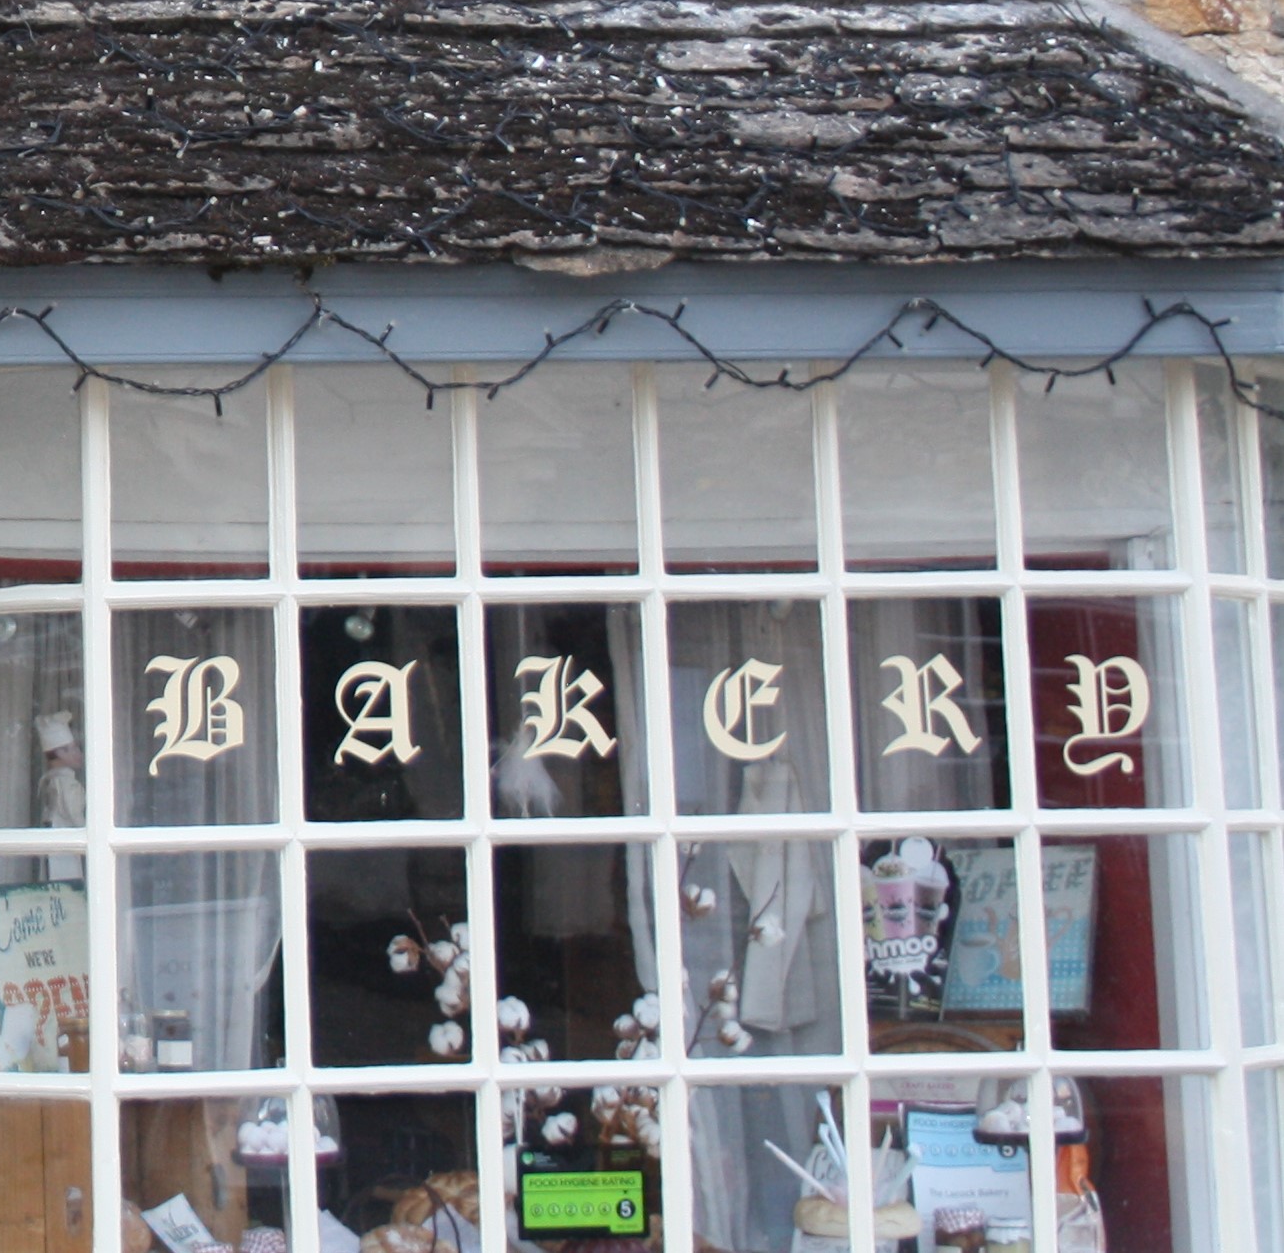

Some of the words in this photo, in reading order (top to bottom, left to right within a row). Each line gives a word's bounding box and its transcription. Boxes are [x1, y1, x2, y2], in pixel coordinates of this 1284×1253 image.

[143, 653, 1150, 777] BAKERY
[865, 934, 938, 961] hmoo
[24, 949, 56, 969] WE'RE
[529, 1176, 558, 1187] FOOD
[560, 1176, 600, 1187] HYGIENE
[602, 1176, 636, 1186] RATING
[620, 1200, 632, 1217] 5
